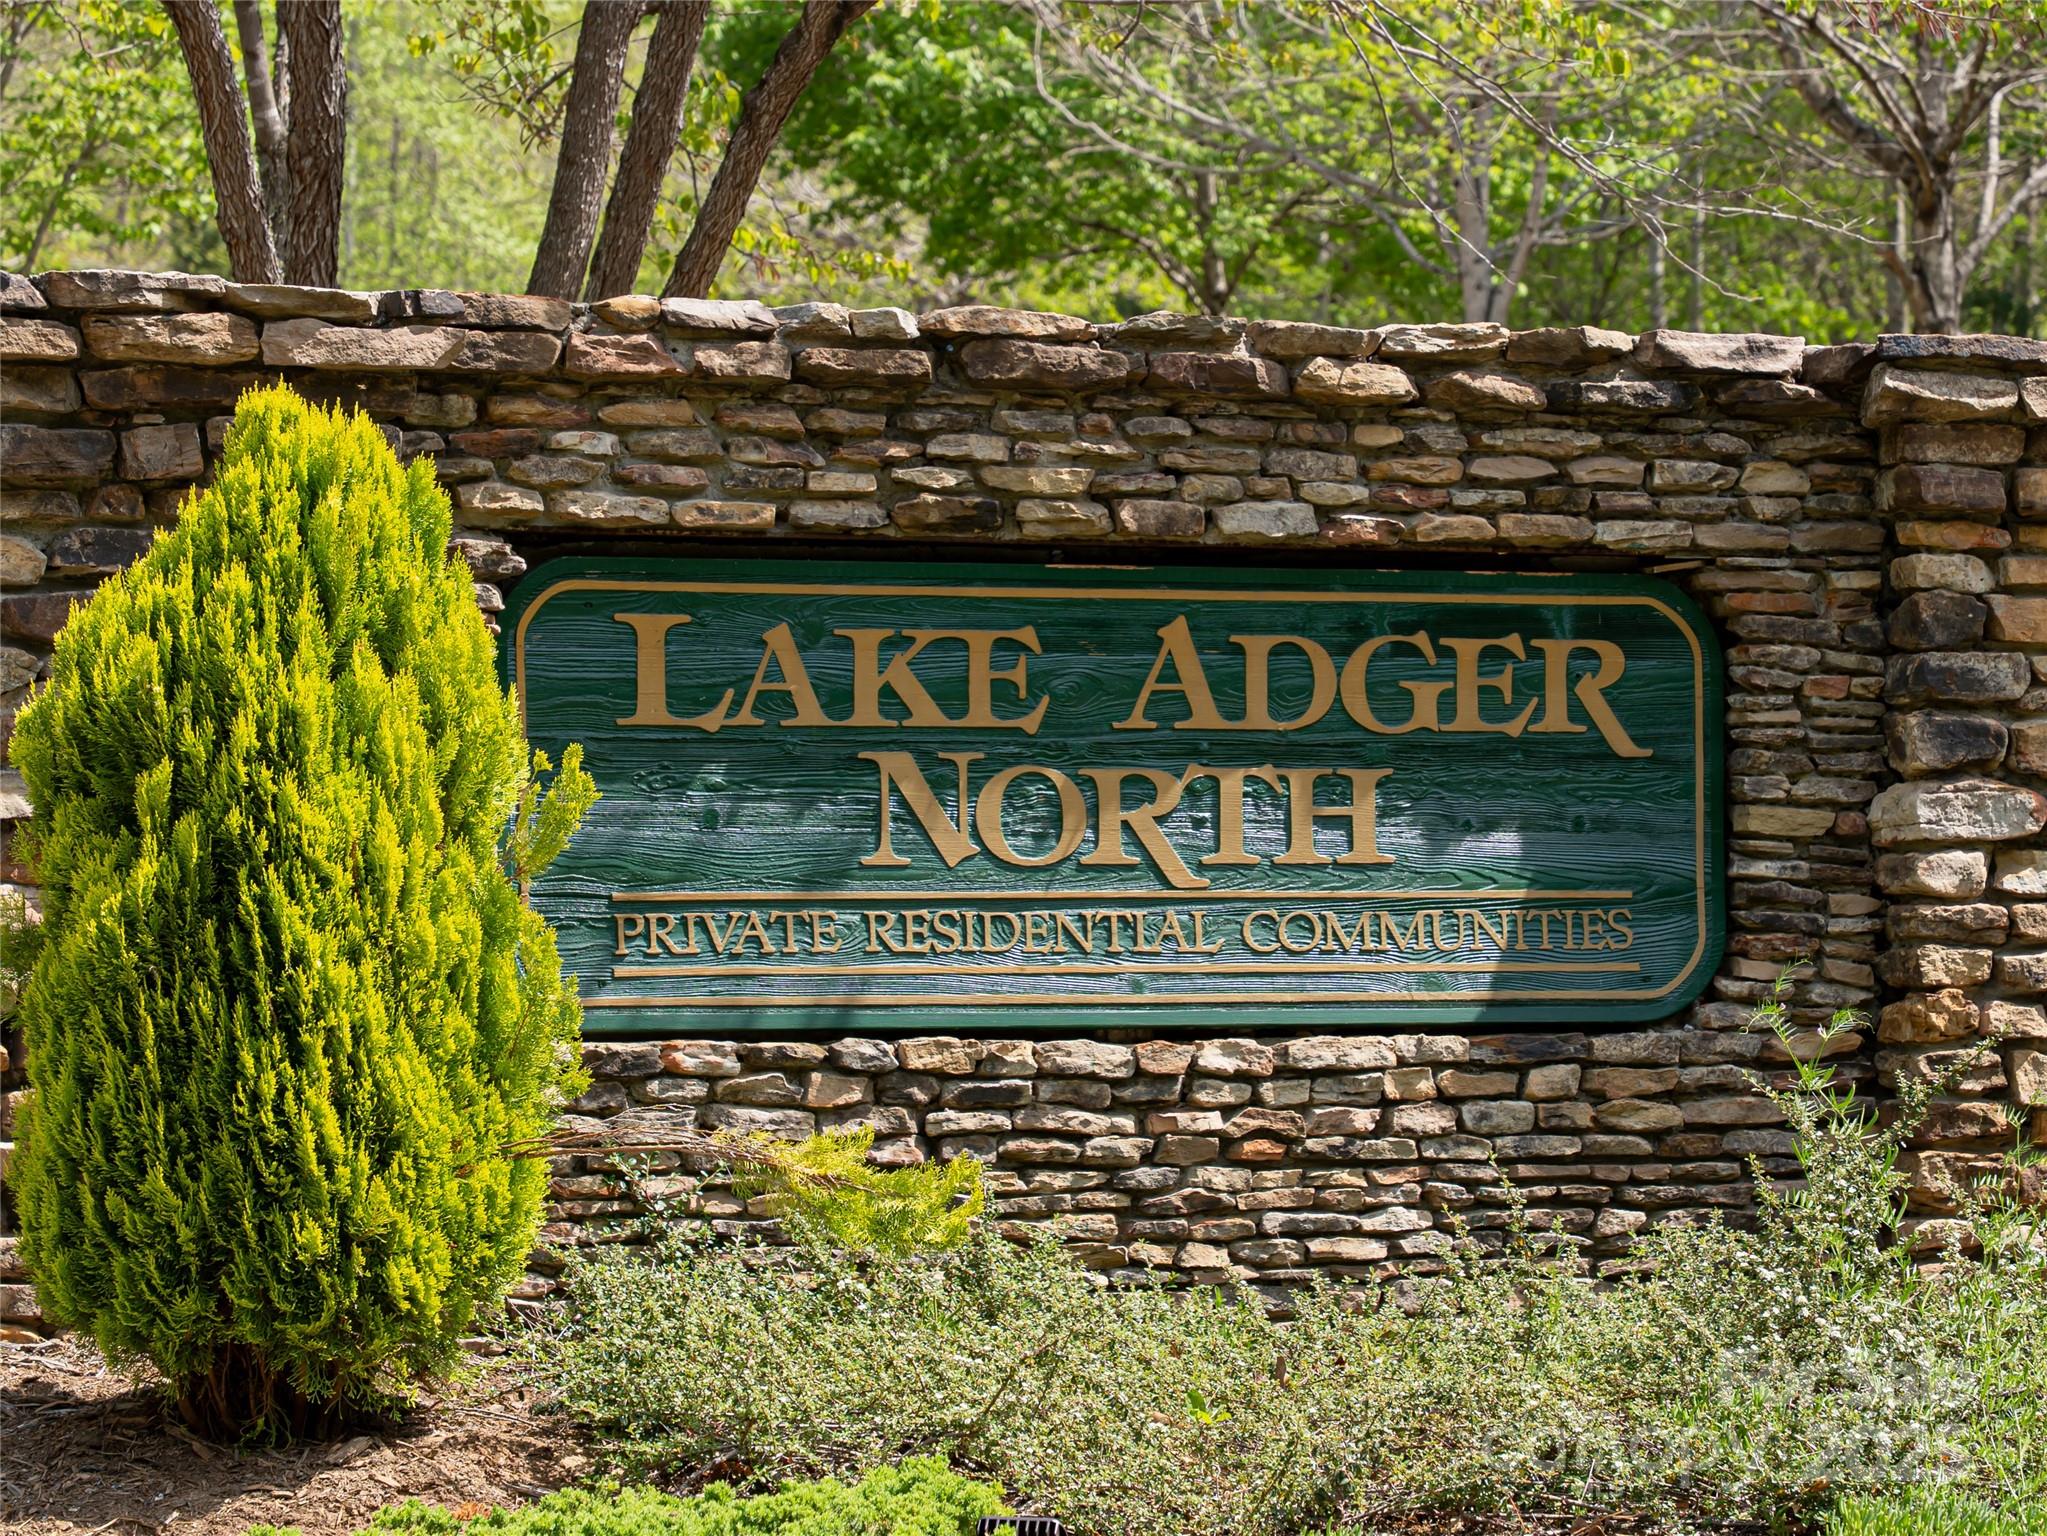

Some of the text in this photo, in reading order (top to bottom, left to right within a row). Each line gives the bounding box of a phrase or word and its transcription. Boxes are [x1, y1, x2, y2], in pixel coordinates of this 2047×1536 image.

[613, 612, 1654, 758] LAKE ADGER
[857, 751, 1396, 889] NORTH
[613, 908, 1635, 956] PRIVATE RESIDENTIAL COMMUNITIES
